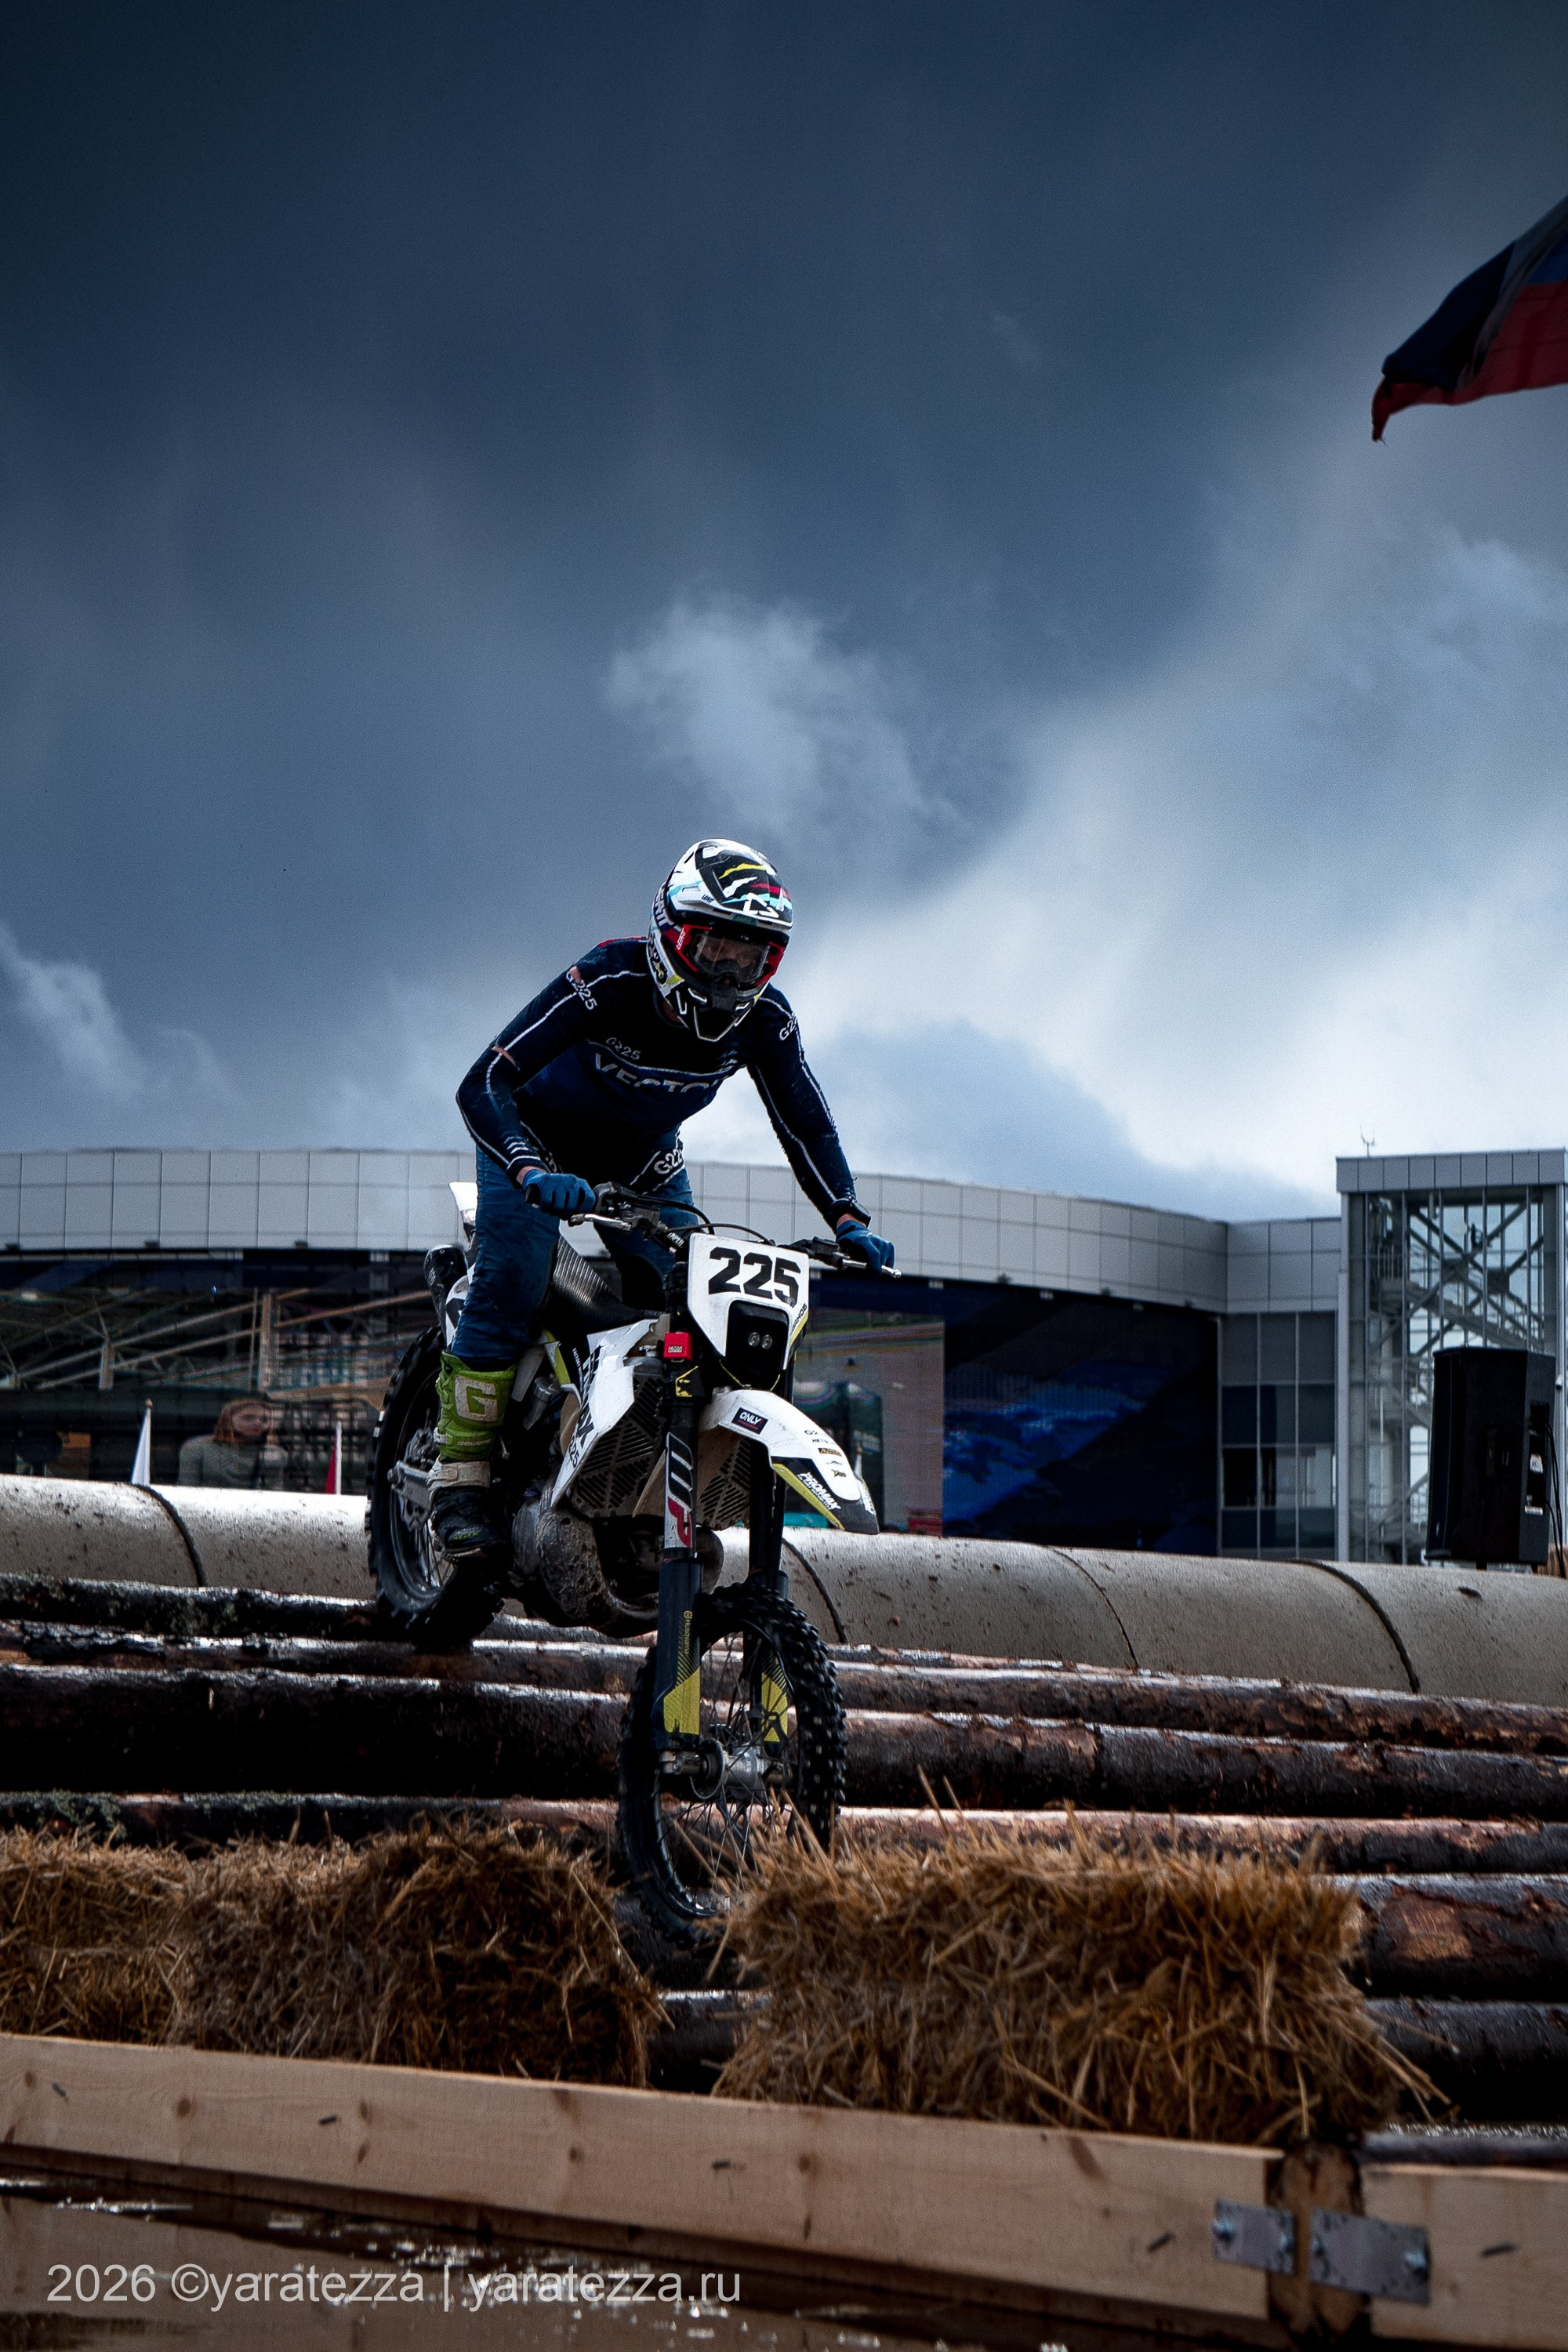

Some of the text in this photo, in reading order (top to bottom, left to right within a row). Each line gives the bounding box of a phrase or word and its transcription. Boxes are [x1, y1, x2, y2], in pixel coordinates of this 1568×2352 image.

[605, 1036, 642, 1061] G225
[708, 1247, 801, 1308] 225
[739, 1411, 763, 1425] ONLY
